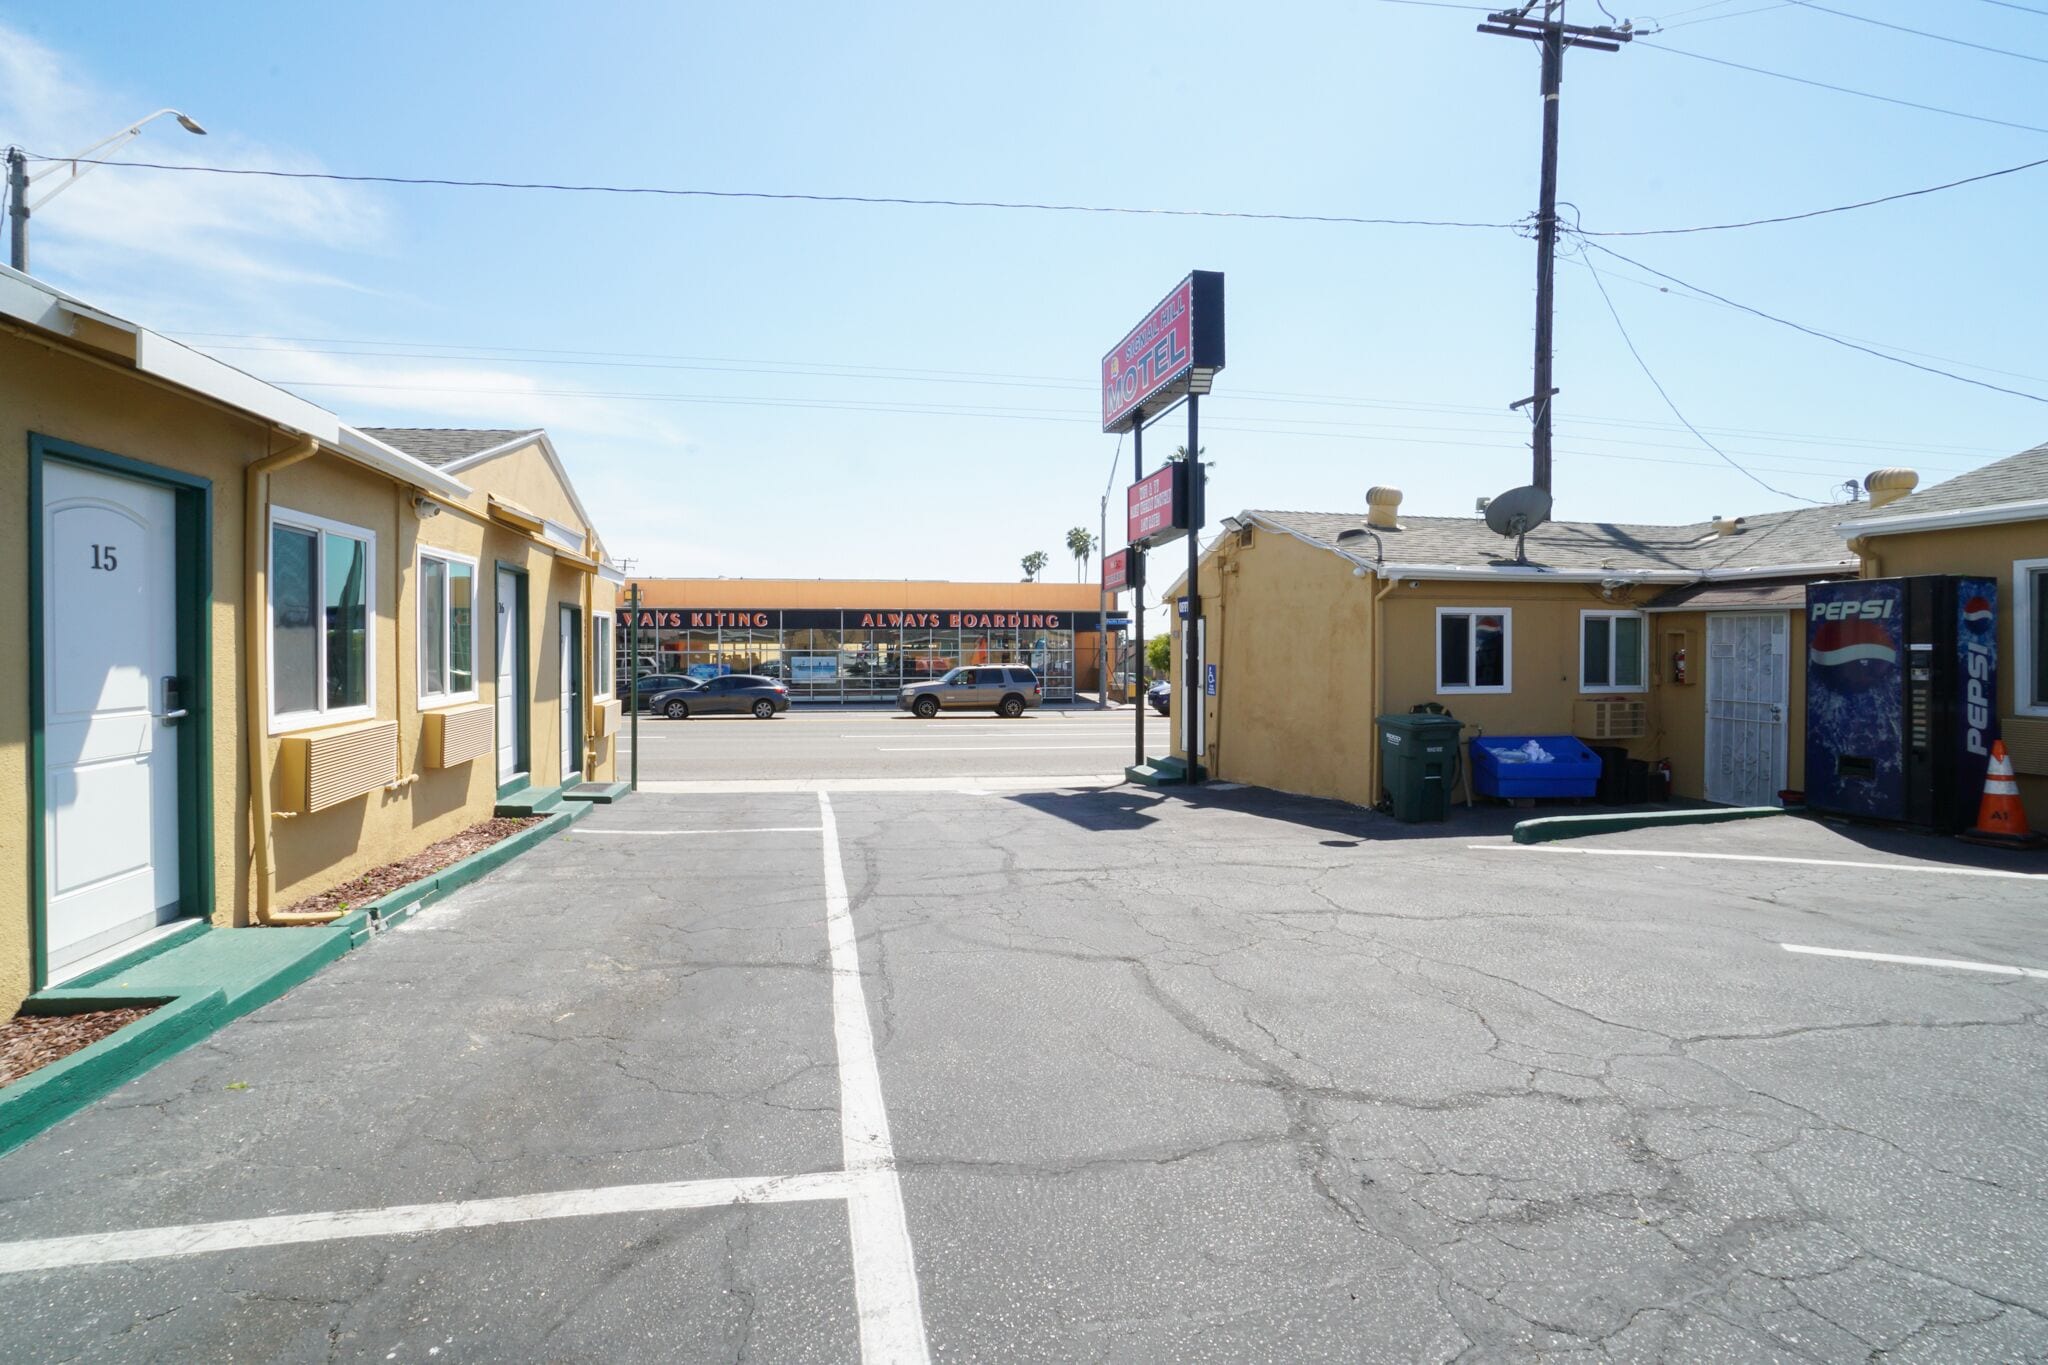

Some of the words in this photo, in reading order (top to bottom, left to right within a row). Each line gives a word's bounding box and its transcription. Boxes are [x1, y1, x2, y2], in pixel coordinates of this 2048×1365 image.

[1124, 317, 1160, 362] SIGNAL
[1160, 295, 1185, 331] HILL
[1106, 327, 1187, 418] MOTEL
[91, 543, 118, 572] 15
[691, 611, 769, 628] KITING
[861, 612, 940, 628] ALWAYS
[949, 612, 1060, 629] BOARDING
[1811, 599, 1894, 622] PEPSI
[1967, 642, 1989, 757] PEPSI
